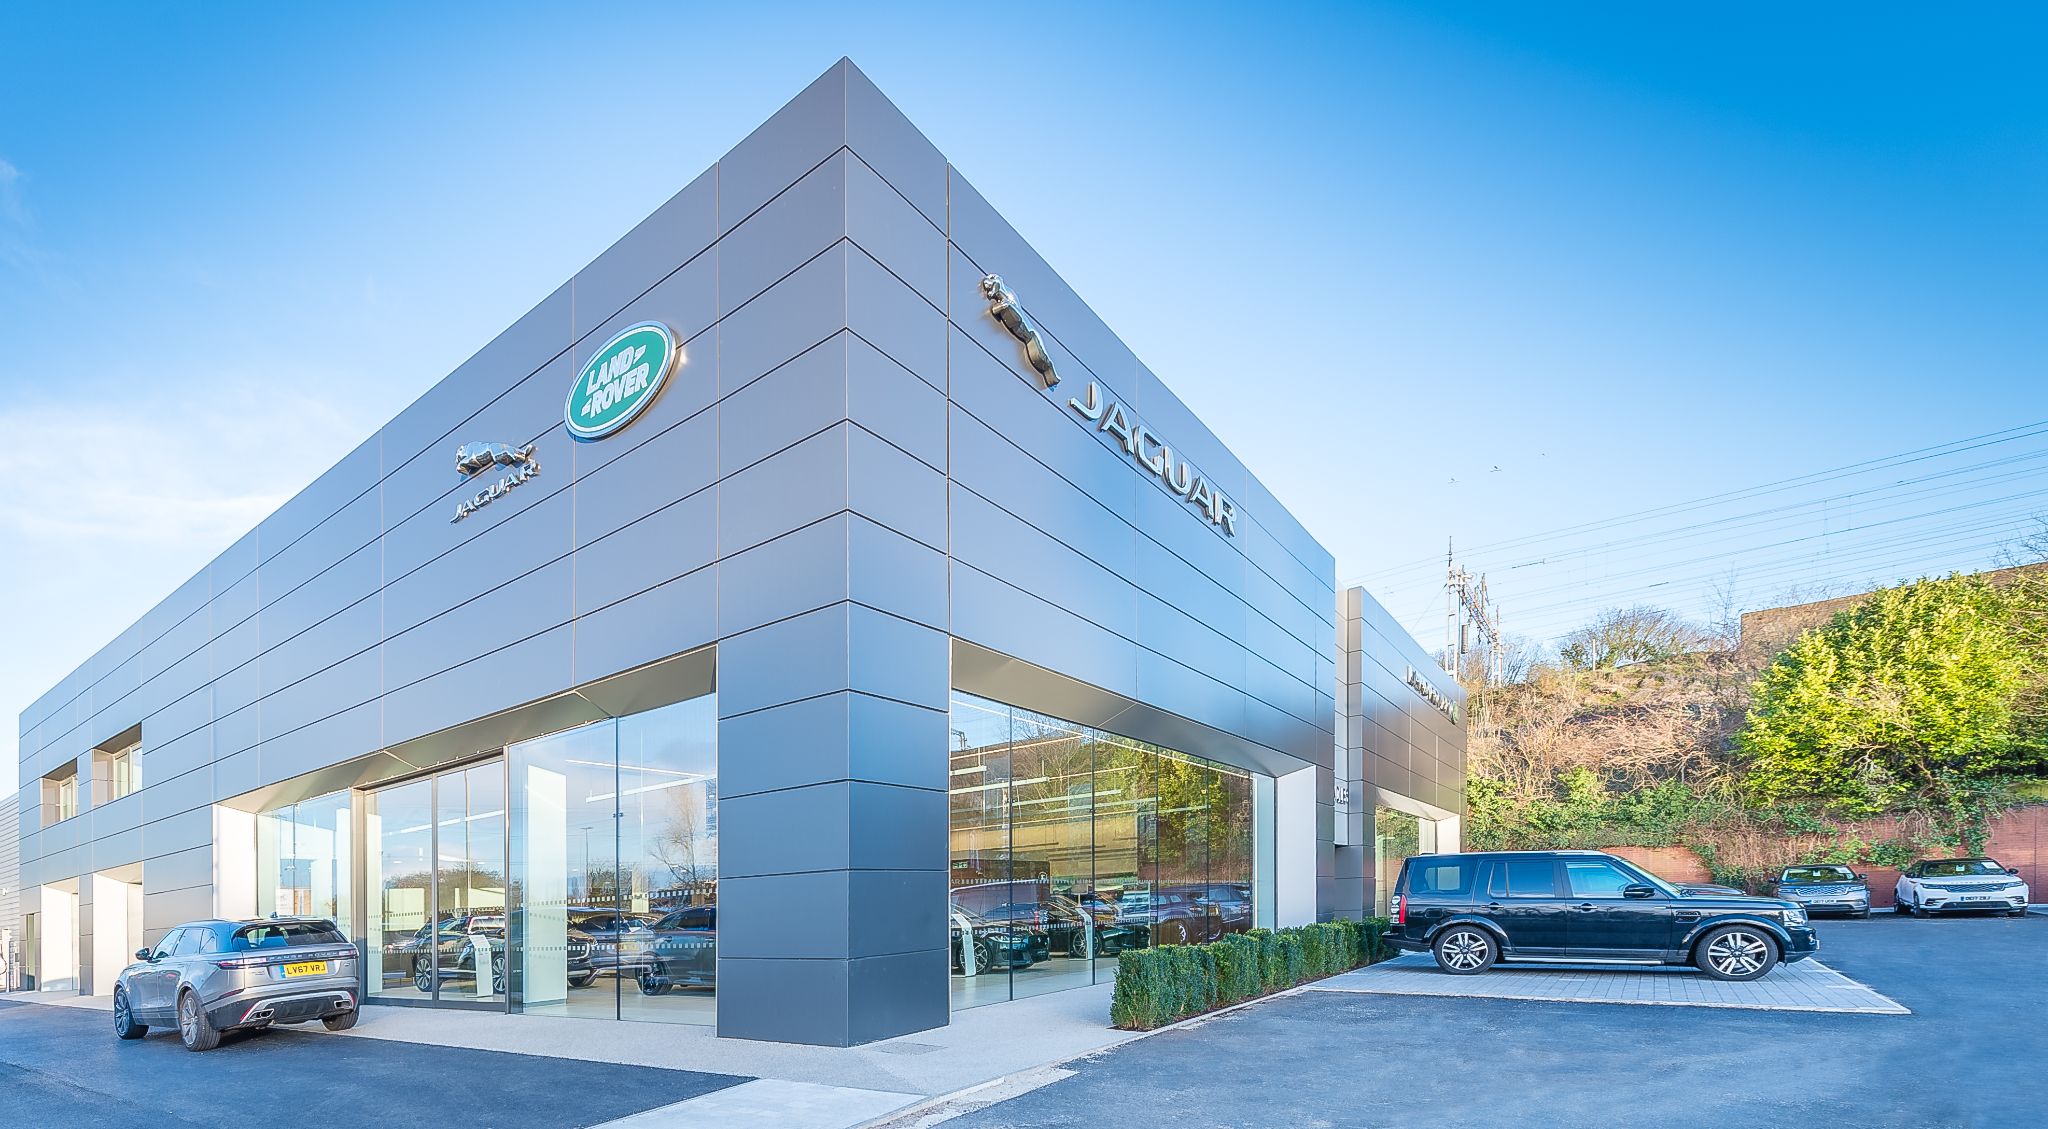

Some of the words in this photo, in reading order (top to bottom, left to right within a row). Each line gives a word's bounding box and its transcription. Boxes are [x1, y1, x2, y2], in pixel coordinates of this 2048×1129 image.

[586, 345, 635, 395] LAND
[590, 362, 650, 418] ROVER
[1067, 381, 1237, 538] JAGUAR
[450, 458, 541, 524] JAGUAR
[286, 965, 308, 975] LV67
[309, 963, 326, 972] VRJ
